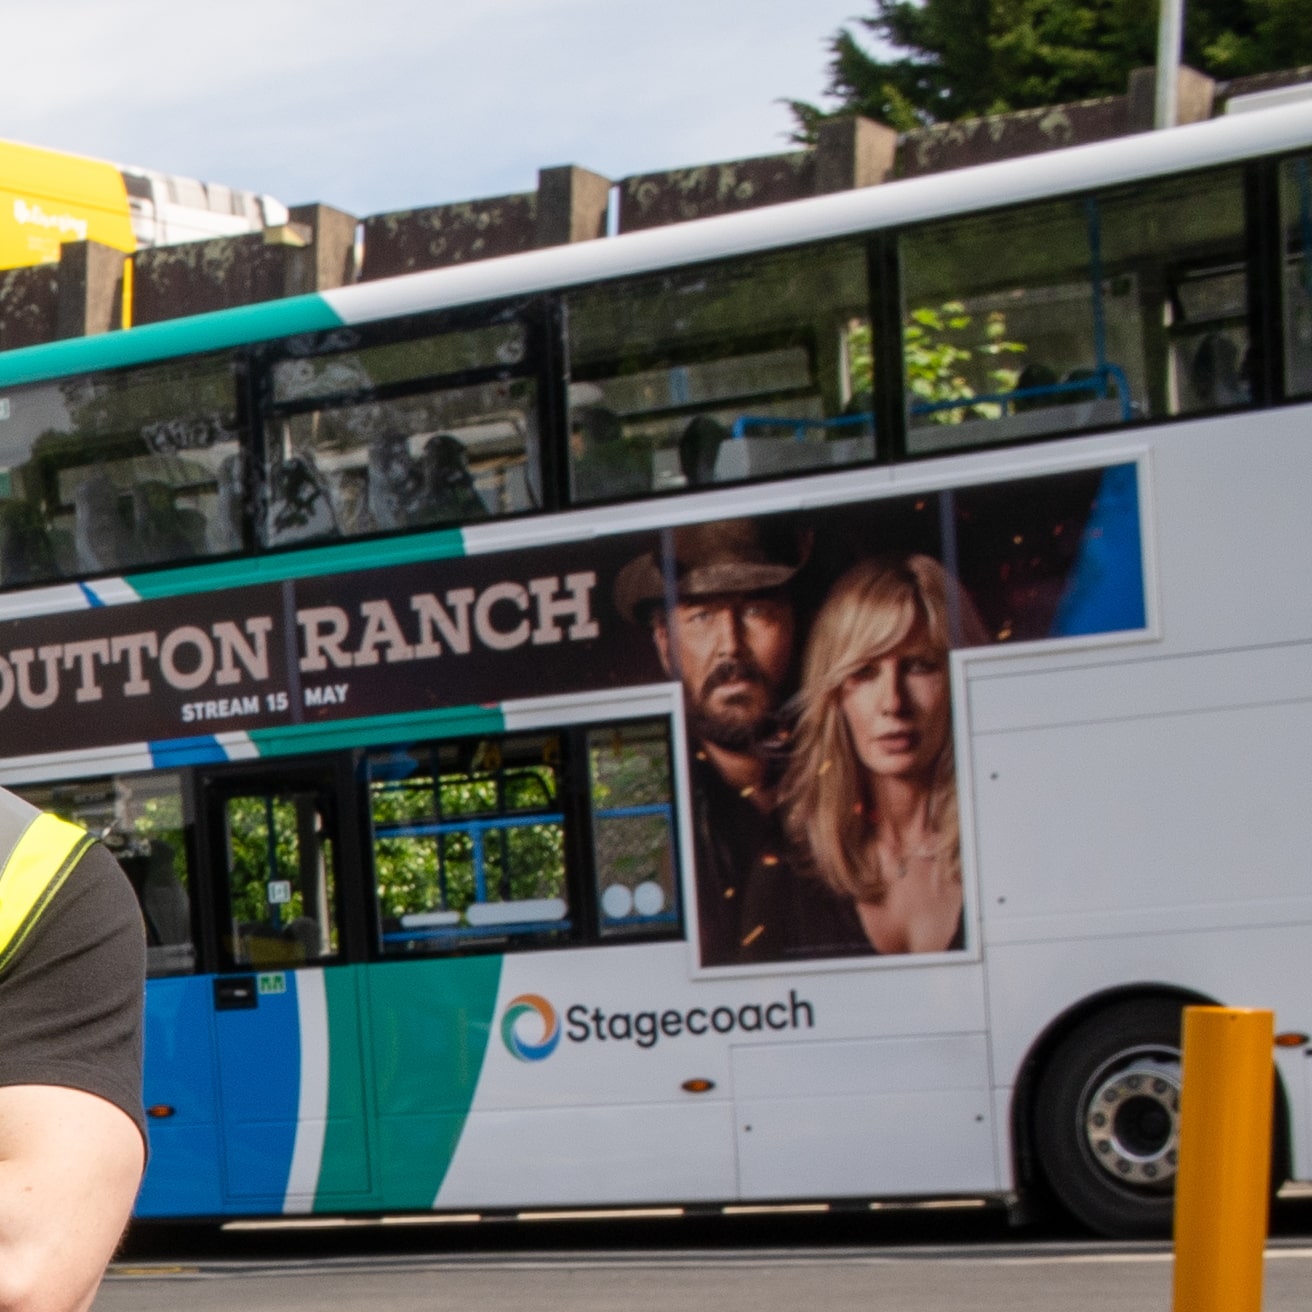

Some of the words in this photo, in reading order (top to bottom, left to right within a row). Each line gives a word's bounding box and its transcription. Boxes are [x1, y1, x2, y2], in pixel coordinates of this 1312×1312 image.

[295, 571, 601, 674] RANCH
[181, 696, 261, 723] STREAM
[266, 692, 290, 714] 15
[304, 683, 350, 708] MAY
[565, 988, 816, 1049] Stagecoach
